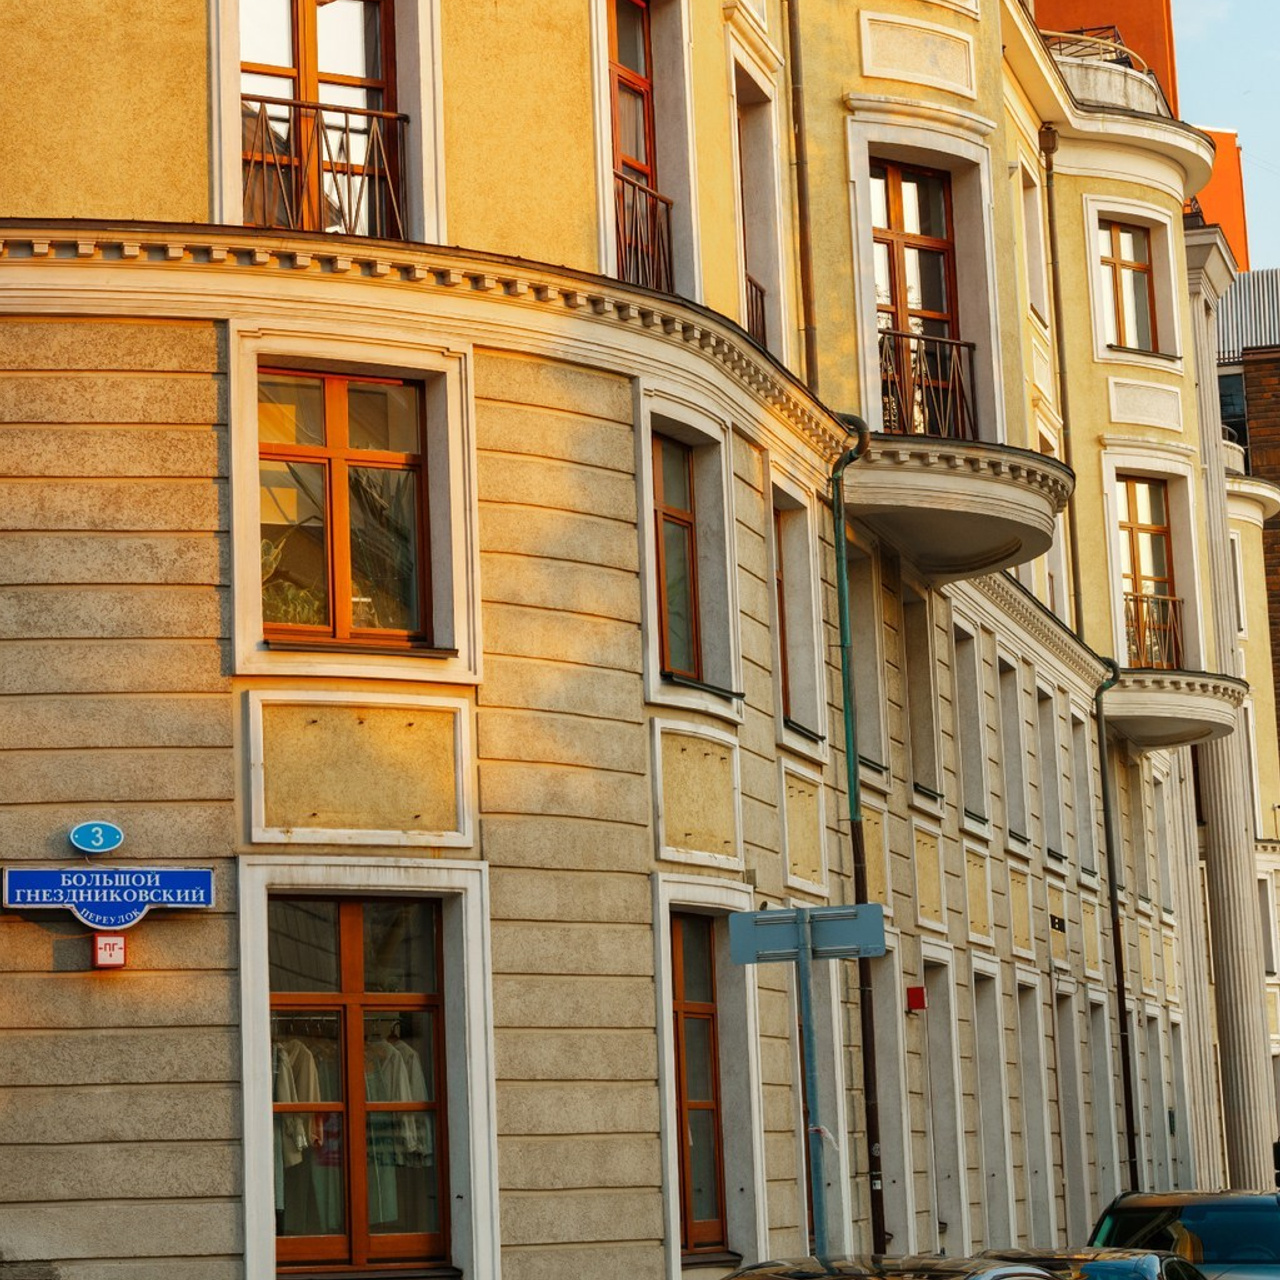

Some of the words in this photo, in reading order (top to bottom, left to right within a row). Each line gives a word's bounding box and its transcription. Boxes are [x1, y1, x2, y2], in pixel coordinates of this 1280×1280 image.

[90, 827, 104, 846] 3
[60, 871, 161, 887] БОЛЬШОЙ
[15, 887, 205, 904] ГНЕЗДНИКОВСКИЙ
[80, 908, 141, 925] ПЕРЕУЛОК
